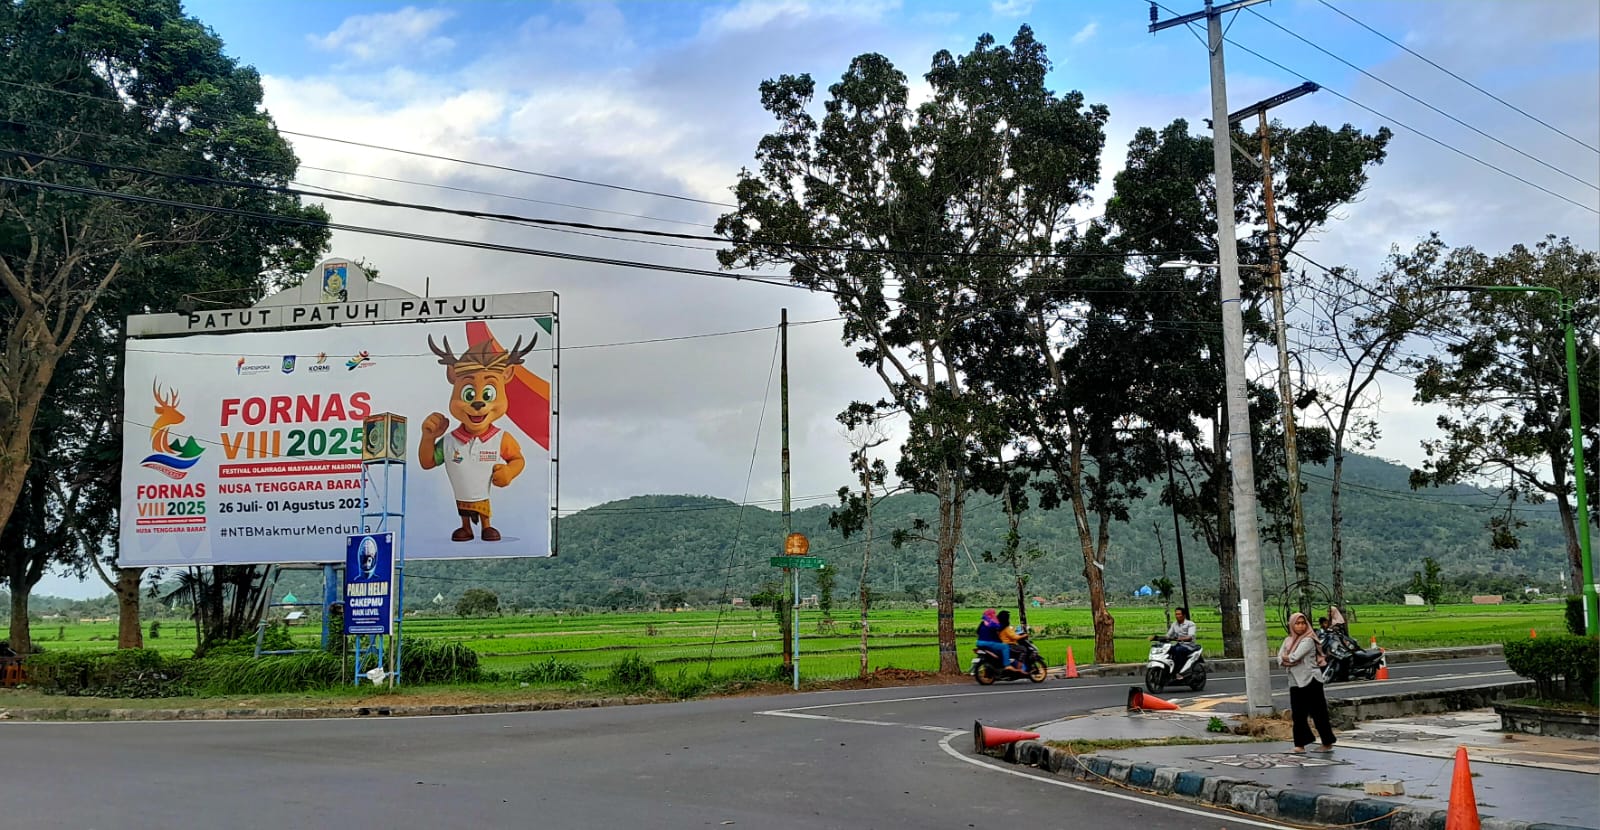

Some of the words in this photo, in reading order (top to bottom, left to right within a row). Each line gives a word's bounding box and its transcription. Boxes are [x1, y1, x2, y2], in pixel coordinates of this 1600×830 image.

[188, 309, 271, 329] PATUT
[293, 303, 378, 323] PATUH
[400, 298, 486, 317] PATJU
[220, 392, 371, 426] FORNAS
[220, 430, 281, 460] VIII
[286, 427, 364, 457] 2025
[287, 464, 330, 472] MASYARAKAT
[137, 483, 206, 500] FORNAS
[219, 483, 252, 494] NUSA
[255, 480, 323, 492] TENGGARA
[327, 479, 369, 490] BARAT
[137, 502, 165, 516] VIII
[167, 501, 206, 516] 2025
[219, 502, 233, 513] 26
[266, 500, 279, 511] 01
[282, 499, 335, 514] Agustus
[339, 498, 369, 509] 2025
[220, 523, 371, 537] #NTBMakmurMenduna
[347, 582, 367, 597] PAKAI
[368, 581, 388, 596] HELM
[350, 597, 383, 608] CAKEPMU
